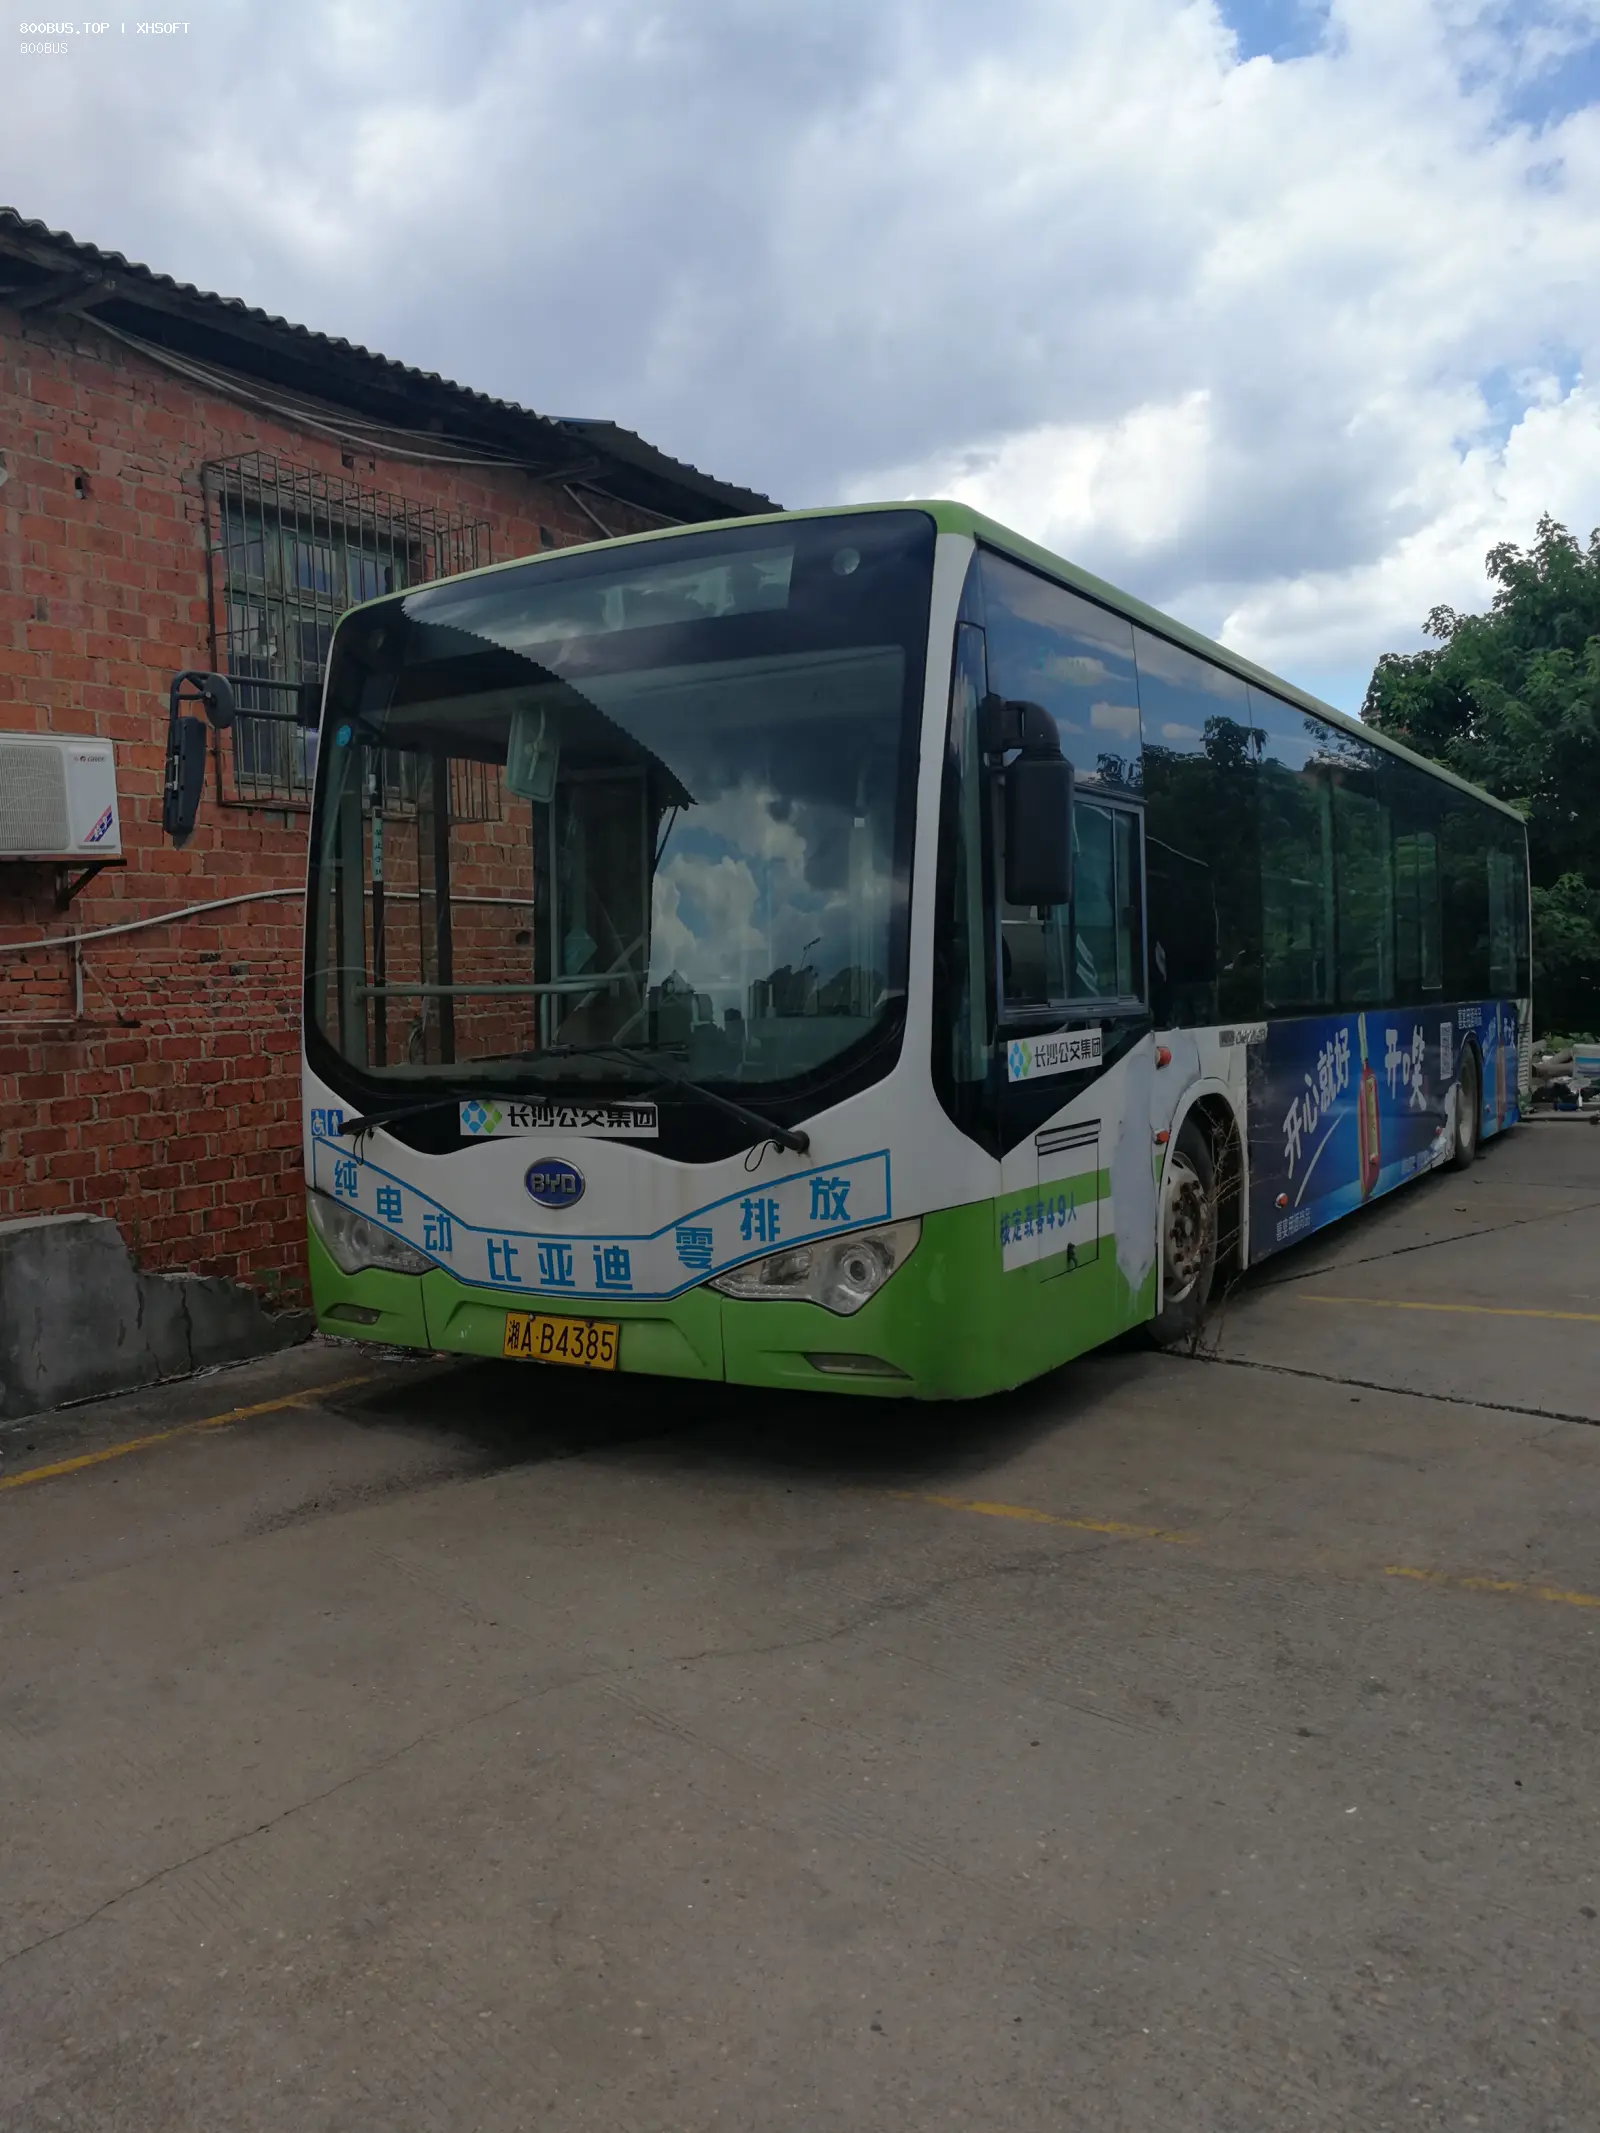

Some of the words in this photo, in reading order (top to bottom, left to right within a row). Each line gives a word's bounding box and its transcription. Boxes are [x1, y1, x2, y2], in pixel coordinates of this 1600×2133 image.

[1034, 1036, 1102, 1068] 长沙公交集团
[507, 1104, 657, 1128] 长沙公交集团
[1282, 1027, 1350, 1180] 开心就好
[531, 1172, 577, 1194] BYD
[334, 1158, 453, 1253] 纯电动
[486, 1238, 634, 1291] 比亚迪
[675, 1176, 851, 1270] 零排放
